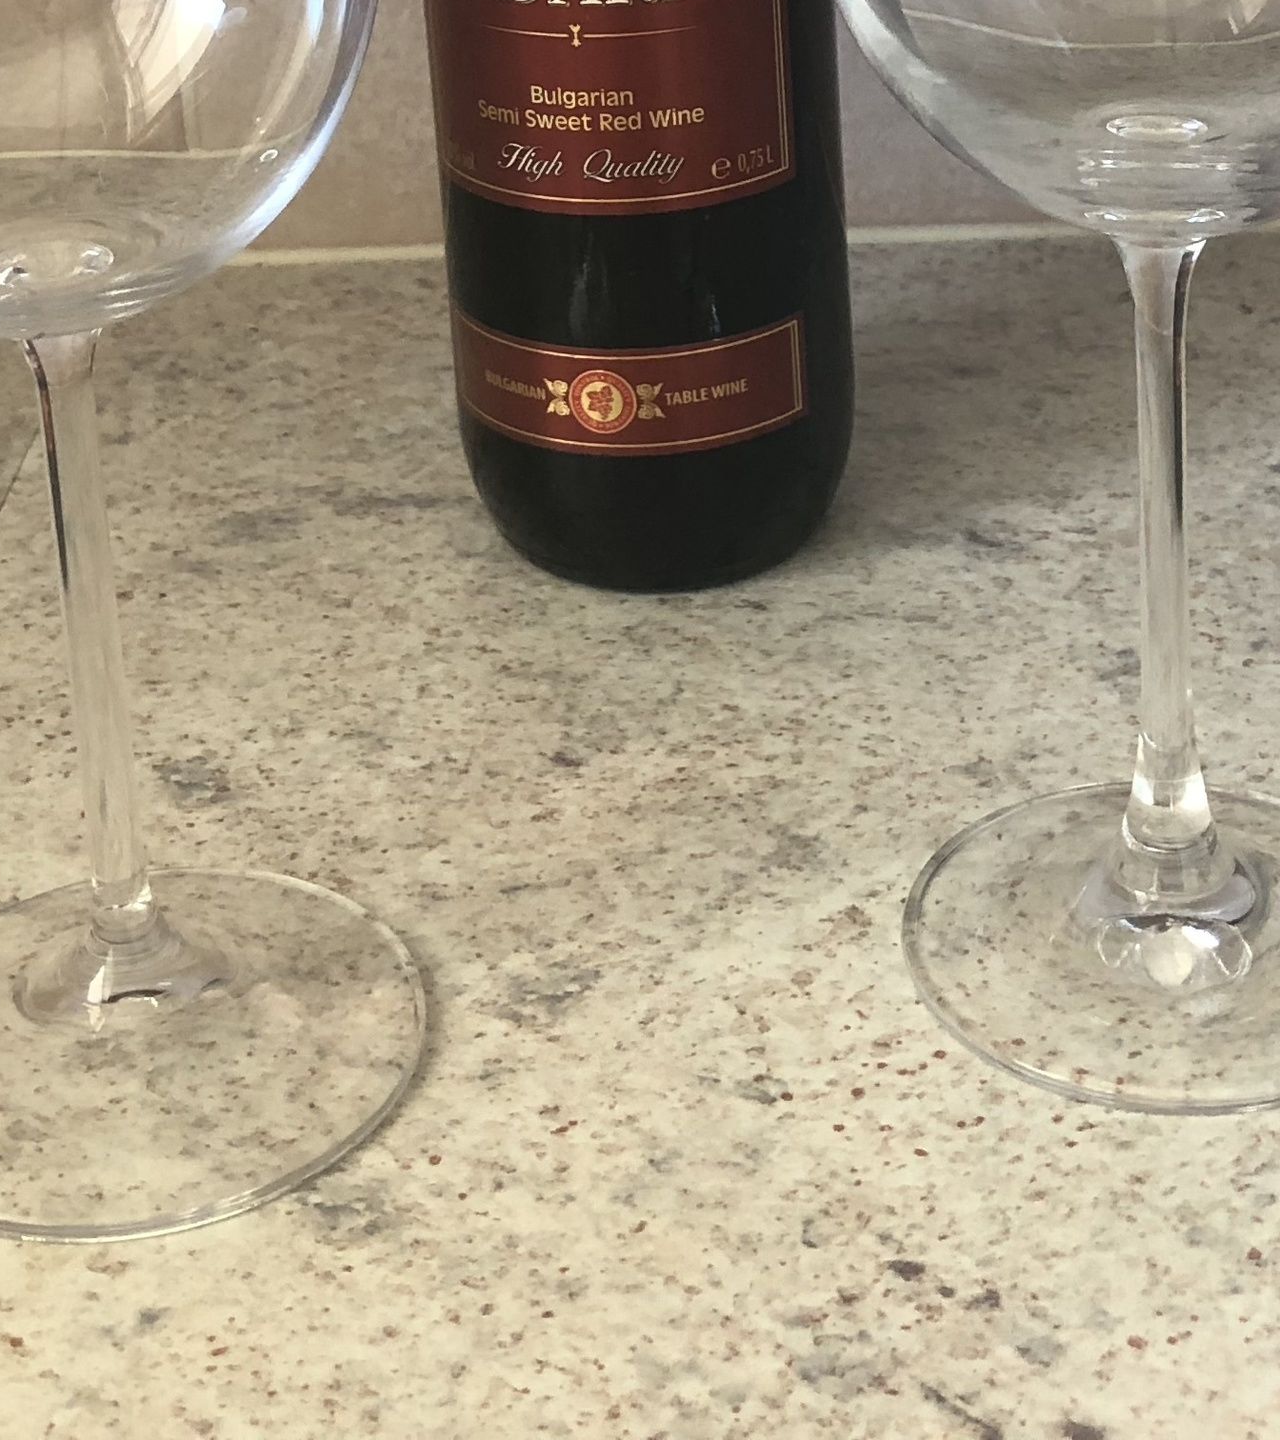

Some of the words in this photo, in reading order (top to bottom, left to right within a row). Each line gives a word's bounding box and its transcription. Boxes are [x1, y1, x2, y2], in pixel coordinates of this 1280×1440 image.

[530, 85, 634, 108] Bulgarian
[478, 99, 520, 126] Semi
[524, 109, 593, 132] Sweet
[599, 111, 642, 131] Red
[649, 107, 705, 129] Wine
[497, 142, 565, 183] High
[582, 148, 685, 184] Quality
[484, 369, 546, 400] BULGARIAN
[664, 387, 710, 406] TABLE
[710, 378, 749, 399] WINE
